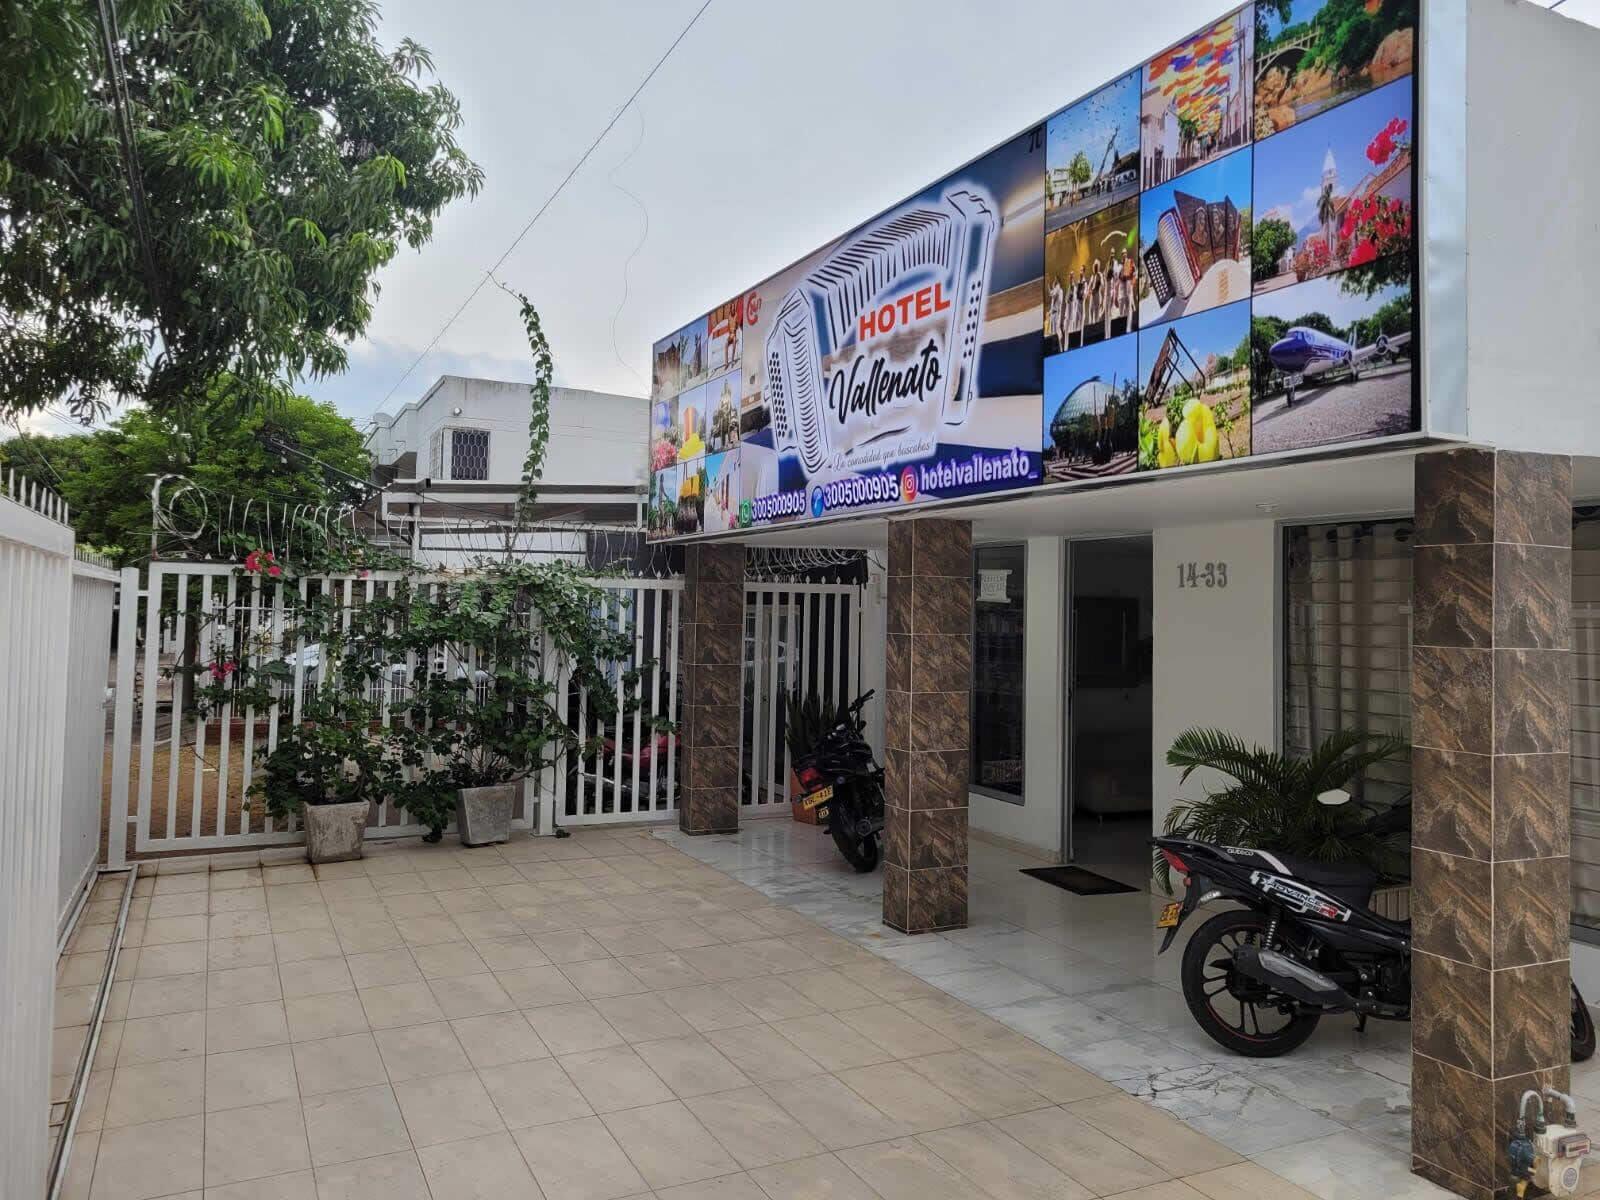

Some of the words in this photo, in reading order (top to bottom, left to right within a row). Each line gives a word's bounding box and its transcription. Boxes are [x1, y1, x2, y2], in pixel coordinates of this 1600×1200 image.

[857, 281, 951, 342] HOTEL
[829, 338, 943, 425] Vallenato
[751, 490, 807, 521] 3005000905
[823, 474, 899, 508] 3005000905
[1176, 562, 1228, 589] 14-33
